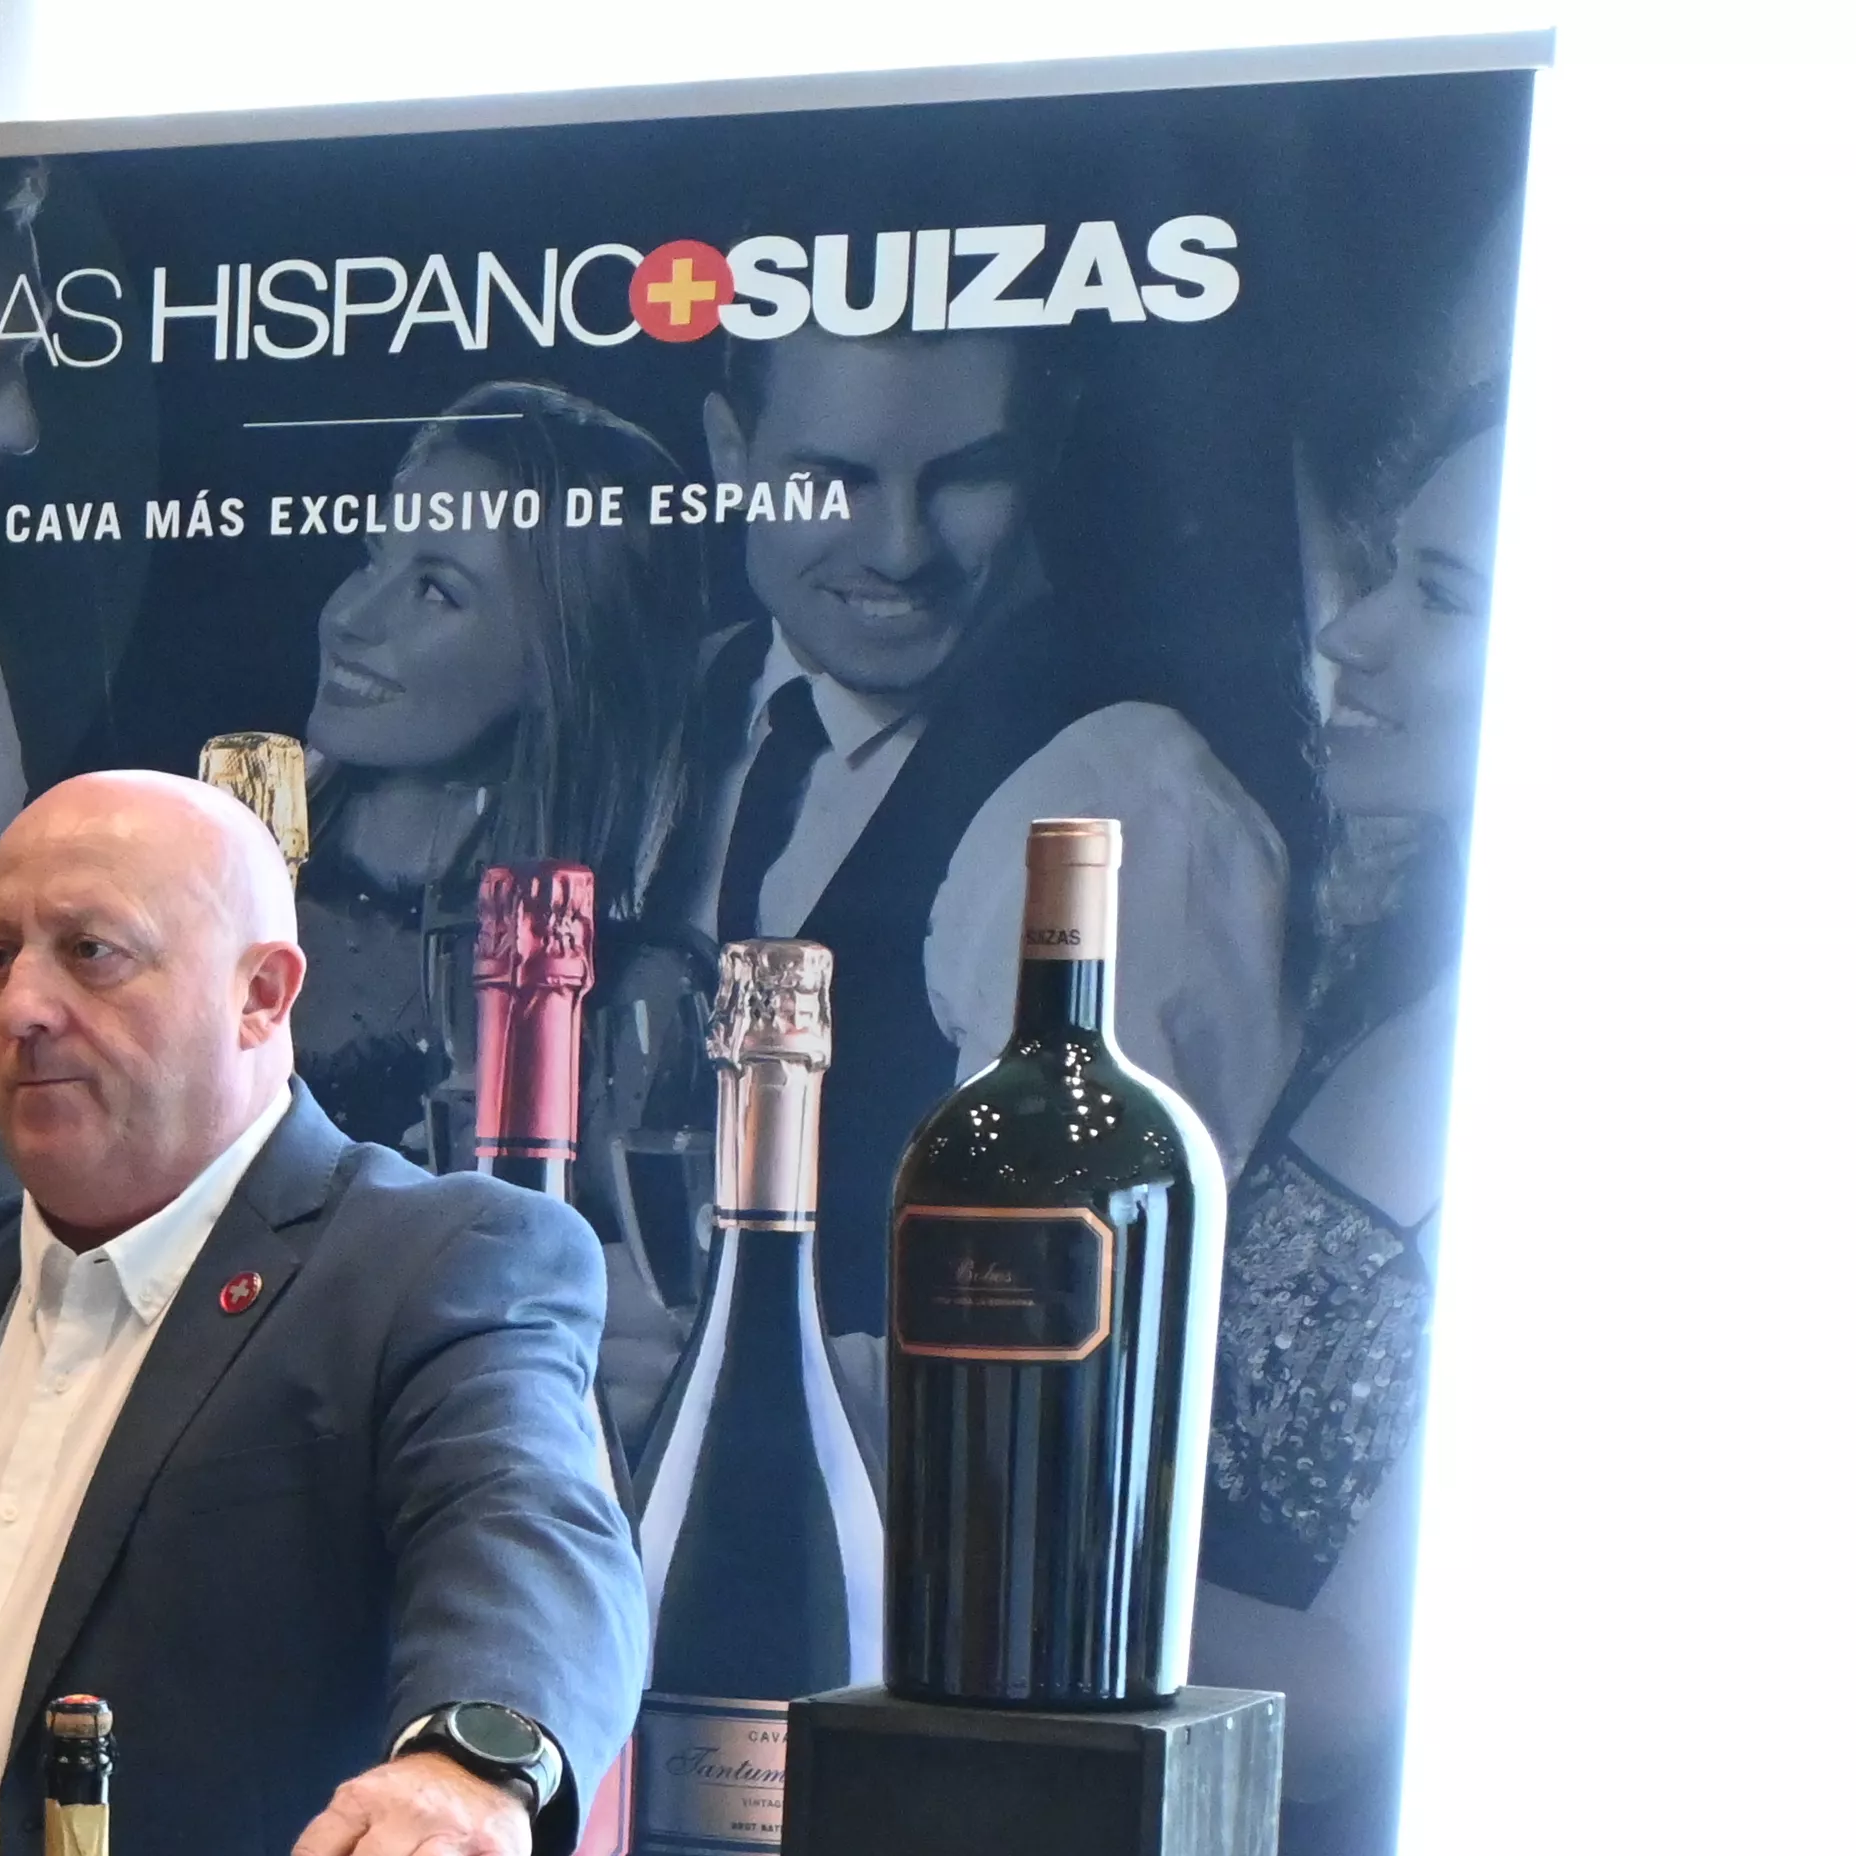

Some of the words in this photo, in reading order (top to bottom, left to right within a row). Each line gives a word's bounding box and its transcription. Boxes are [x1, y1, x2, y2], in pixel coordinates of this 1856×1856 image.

[6, 502, 122, 543] CAVA
[145, 488, 245, 539] MÁS
[269, 487, 540, 535] EXCLUSIVO
[565, 486, 624, 528] DE
[650, 471, 852, 526] ESPAÑA
[741, 1797, 784, 1808] VINTAG
